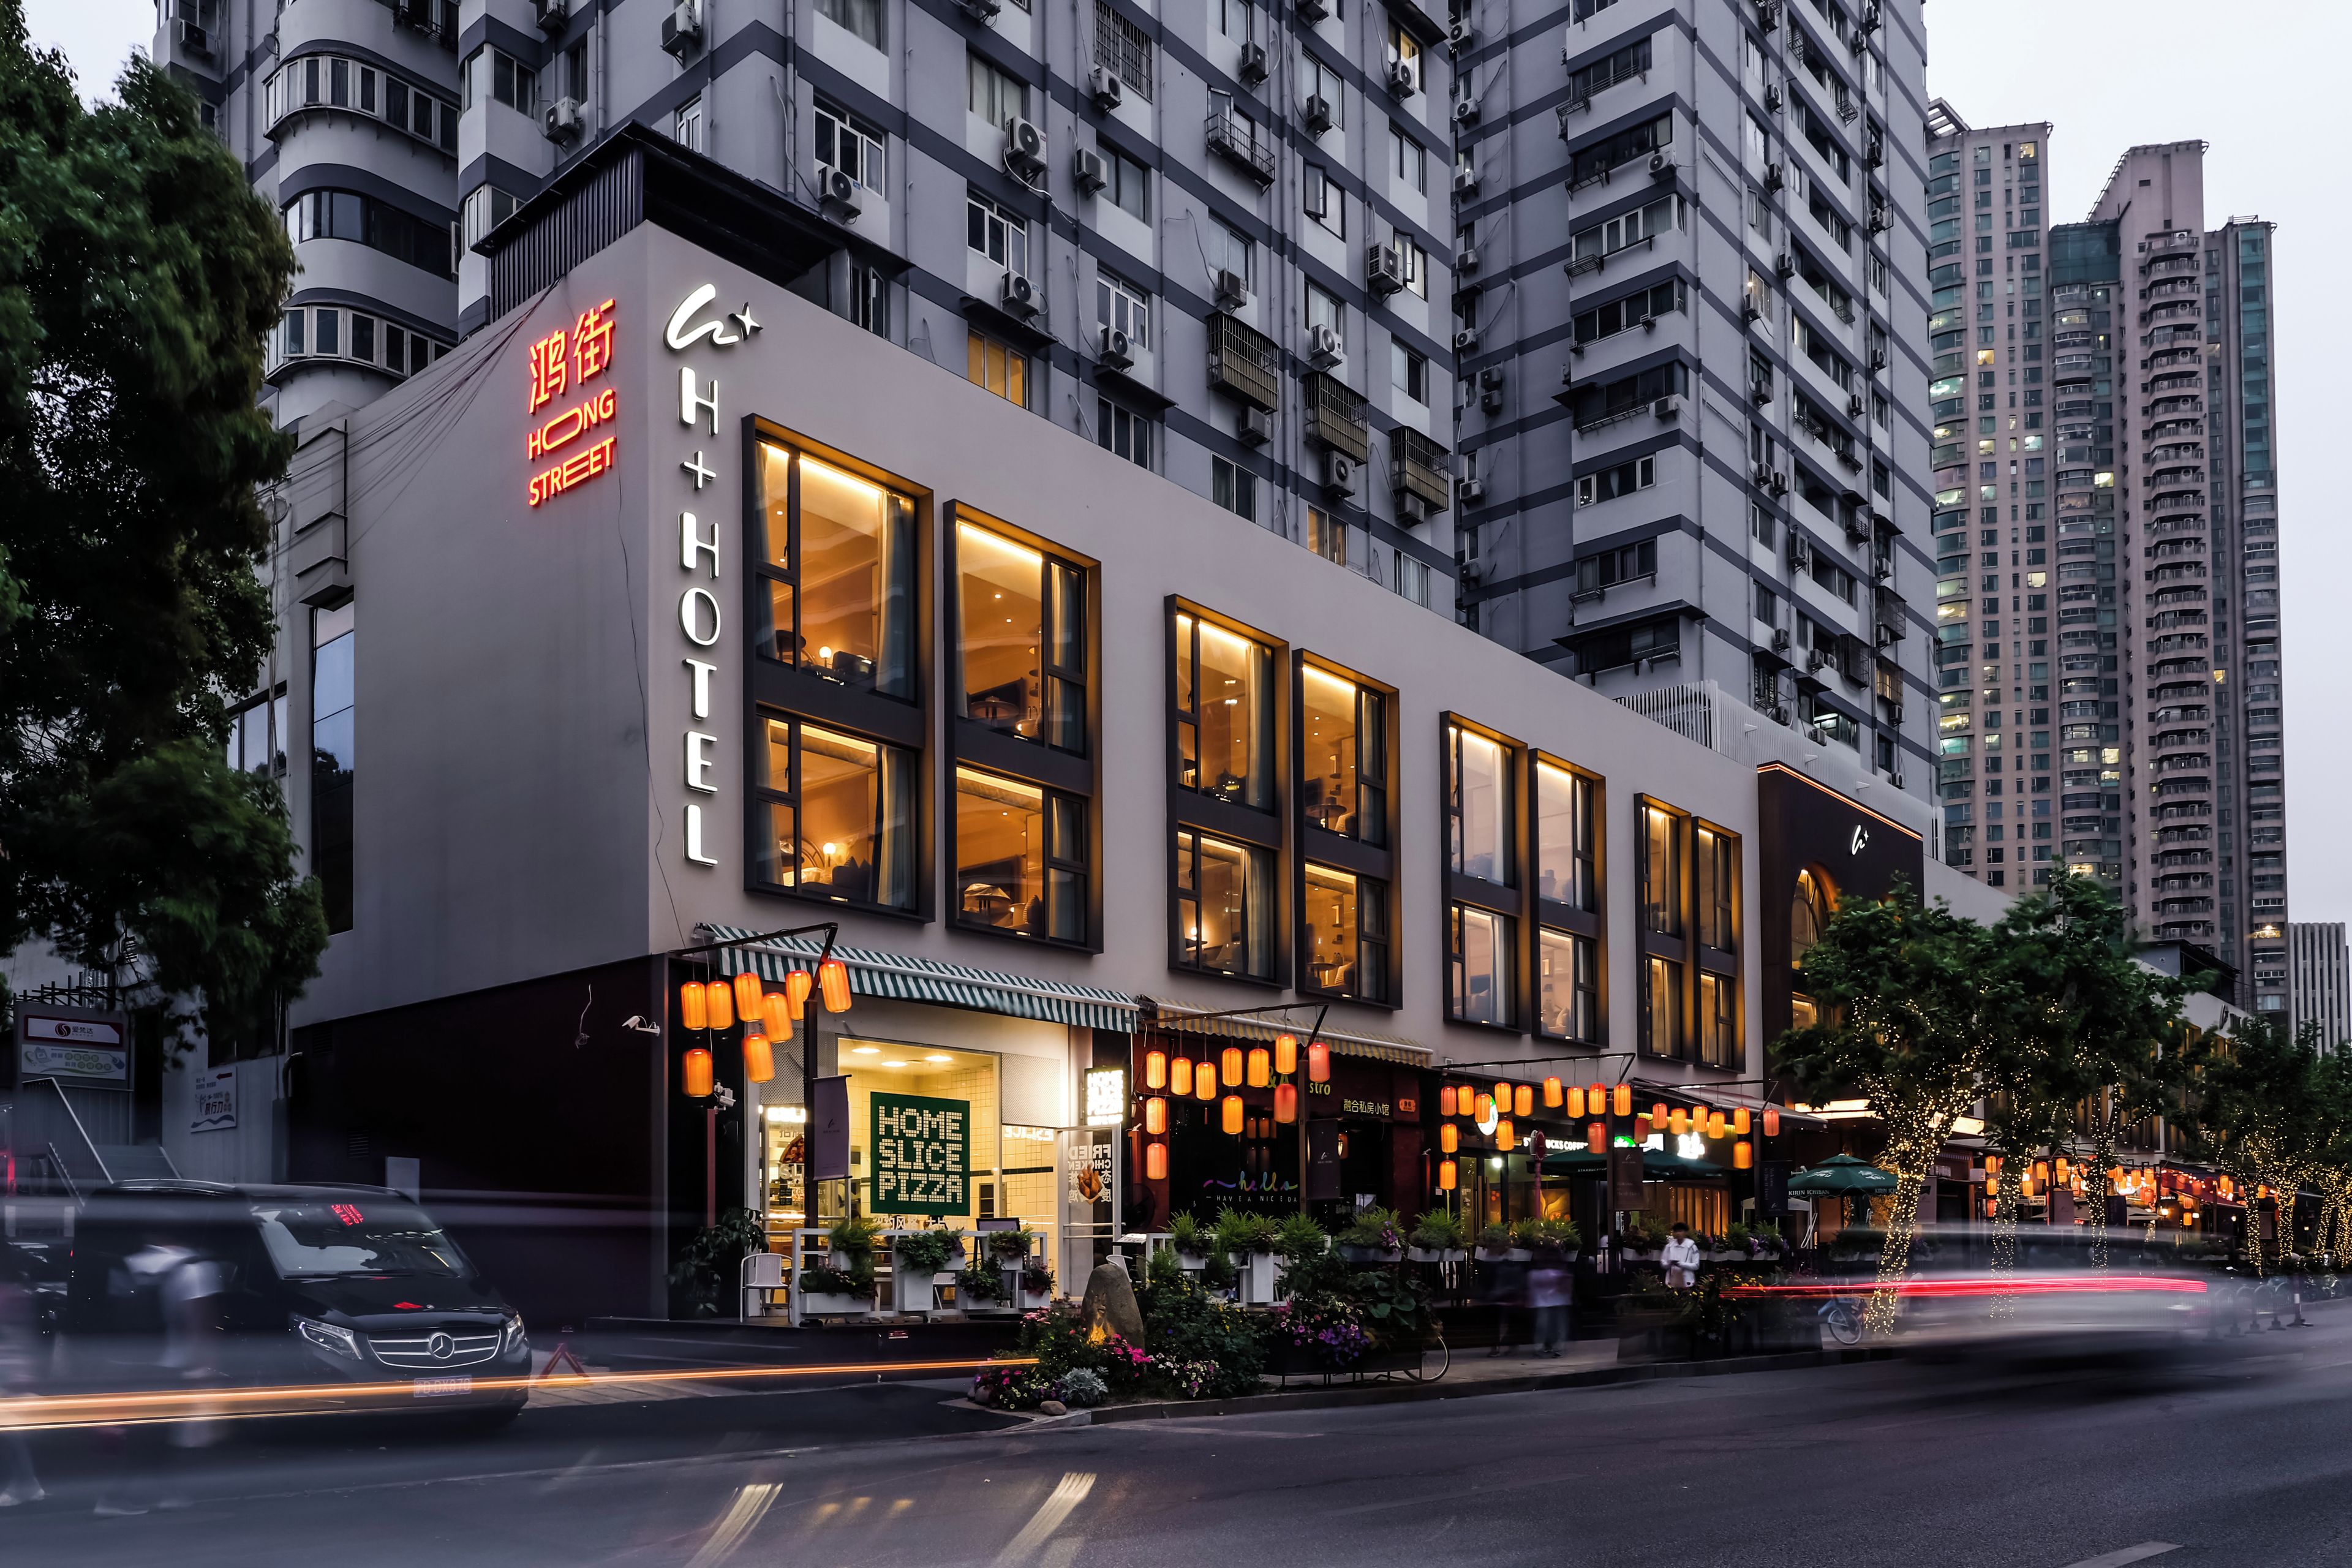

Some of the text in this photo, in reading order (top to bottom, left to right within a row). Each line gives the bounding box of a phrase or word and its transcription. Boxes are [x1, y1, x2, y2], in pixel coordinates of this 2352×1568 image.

[529, 298, 616, 414] 鸿街
[528, 388, 617, 460] HONG
[528, 435, 617, 507] STREET
[879, 1106, 962, 1141] HOME
[1343, 1098, 1390, 1115] 融合私房小馆
[879, 1138, 962, 1172] SLICE
[1523, 1136, 1564, 1150] STUCKS
[879, 1171, 962, 1203] PIZZA
[1238, 1170, 1298, 1191] hello
